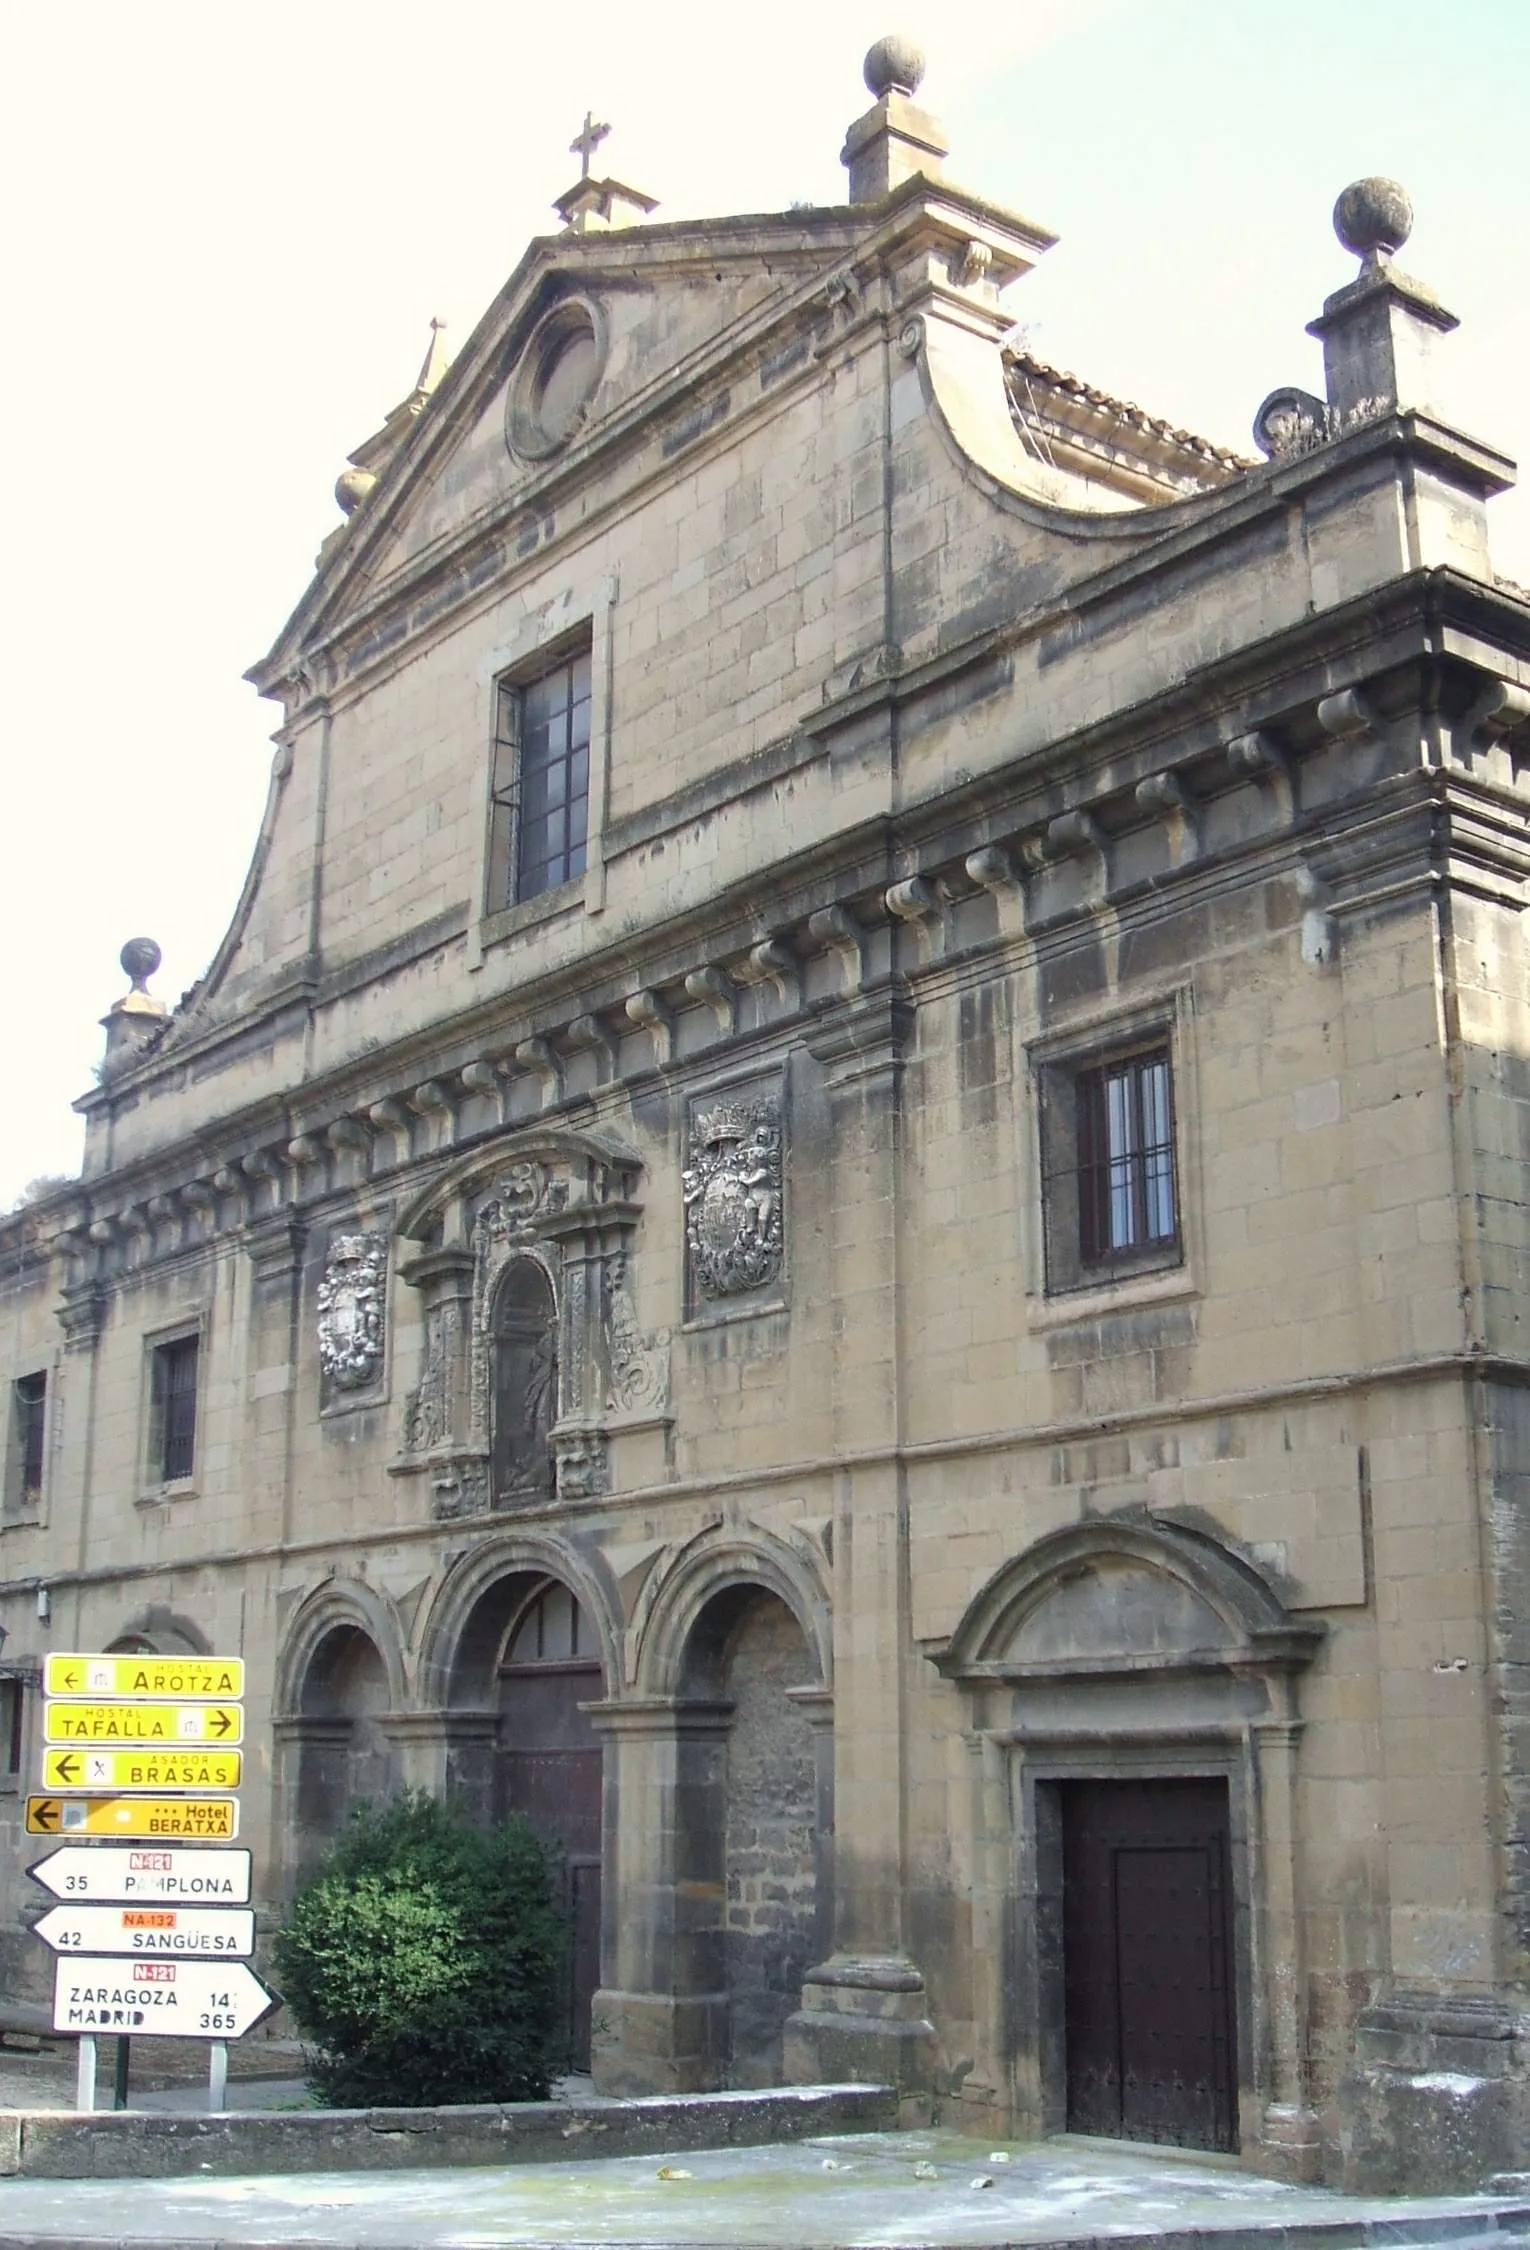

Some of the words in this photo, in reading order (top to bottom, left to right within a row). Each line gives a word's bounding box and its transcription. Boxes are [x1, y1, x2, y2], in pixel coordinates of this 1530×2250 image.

[157, 1664, 211, 1674] HOSTAL
[133, 1671, 233, 1692] AROTZA
[86, 1708, 141, 1719] HOSTAL
[62, 1720, 164, 1737] TAFALLA
[151, 1755, 208, 1765] ASADOR
[131, 1768, 227, 1783] BRASAS
[186, 1805, 228, 1819] Hotel
[149, 1819, 228, 1833] BERATXA
[66, 1876, 88, 1890] 35
[124, 1914, 174, 1926] NA-132
[59, 1932, 81, 1946] 42
[133, 1930, 237, 1949] SANGÜESA
[135, 1965, 175, 1980] N-121
[70, 1987, 178, 2005] ZARAGOZA
[211, 1993, 238, 2008] 14
[69, 2009, 144, 2025] MADRID
[200, 2014, 235, 2029] 365
